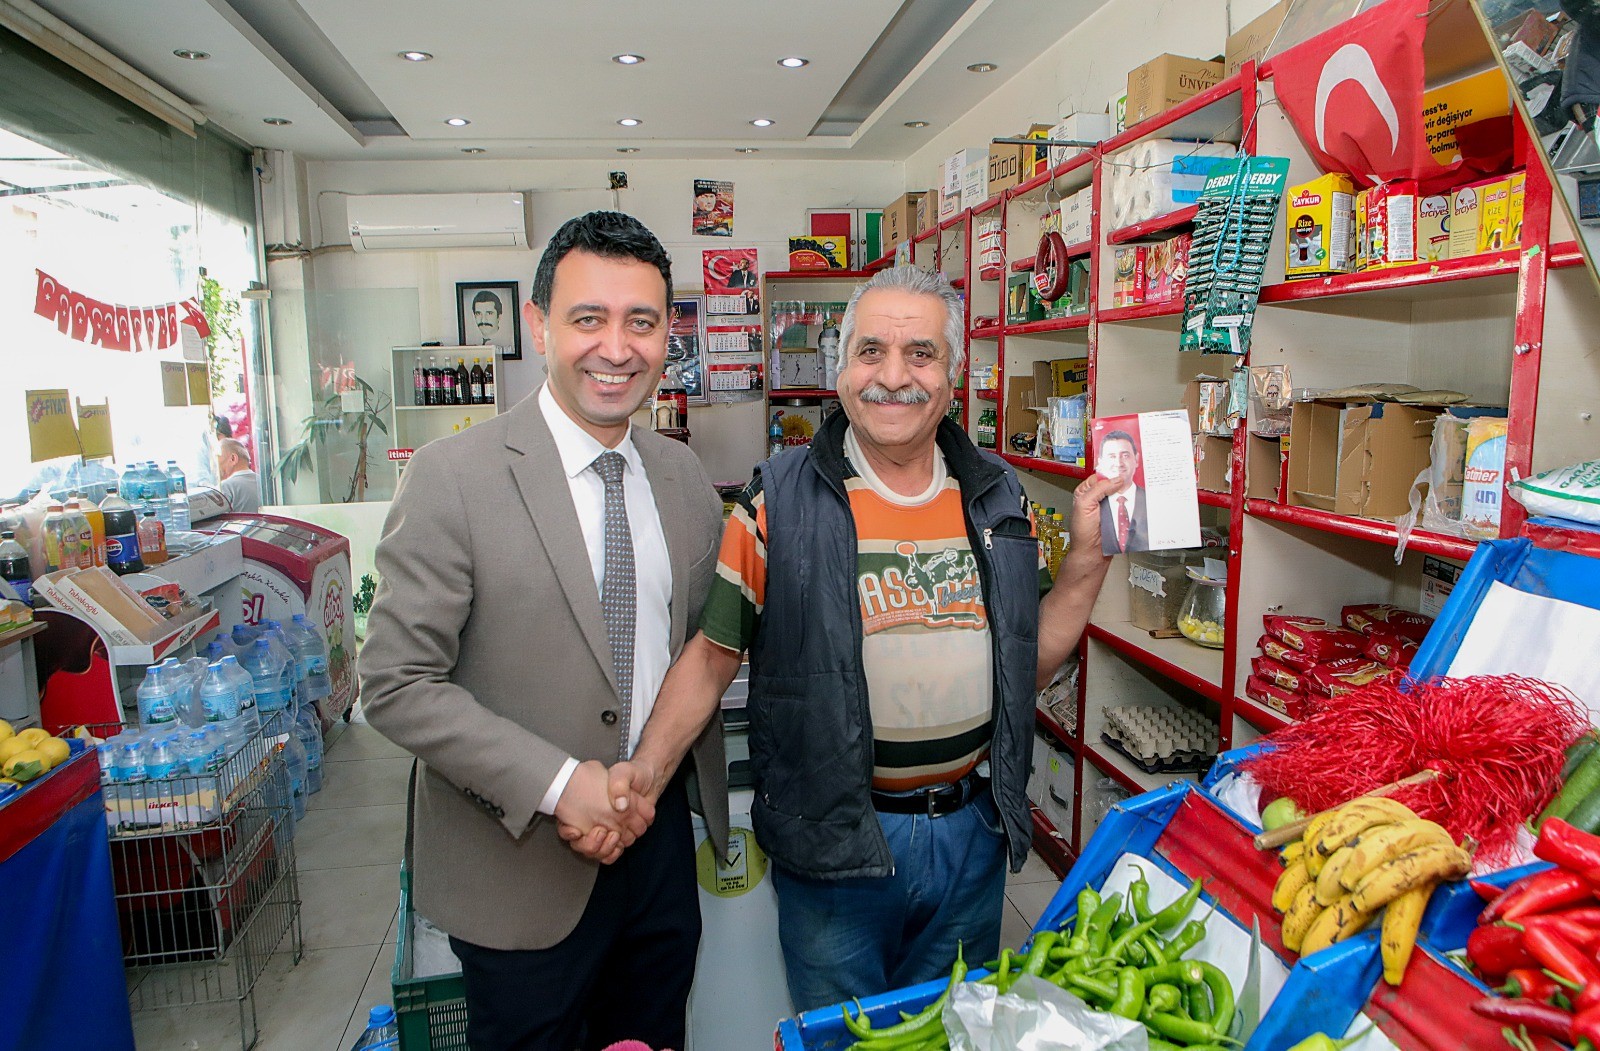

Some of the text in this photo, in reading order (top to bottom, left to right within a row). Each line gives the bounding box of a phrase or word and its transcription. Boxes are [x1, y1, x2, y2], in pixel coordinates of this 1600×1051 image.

[1424, 109, 1473, 129] vir değişiyor
[1426, 126, 1457, 144] ip-para
[1430, 140, 1460, 154] bolmuy
[1206, 174, 1237, 190] DERBY
[1241, 174, 1281, 185] DERBY
[1420, 208, 1449, 218] erciyes
[1455, 202, 1477, 216] erciyes
[1075, 371, 1088, 380] KRE
[782, 437, 812, 446] rkide
[1475, 490, 1496, 504] un
[1332, 658, 1353, 667] filiz
